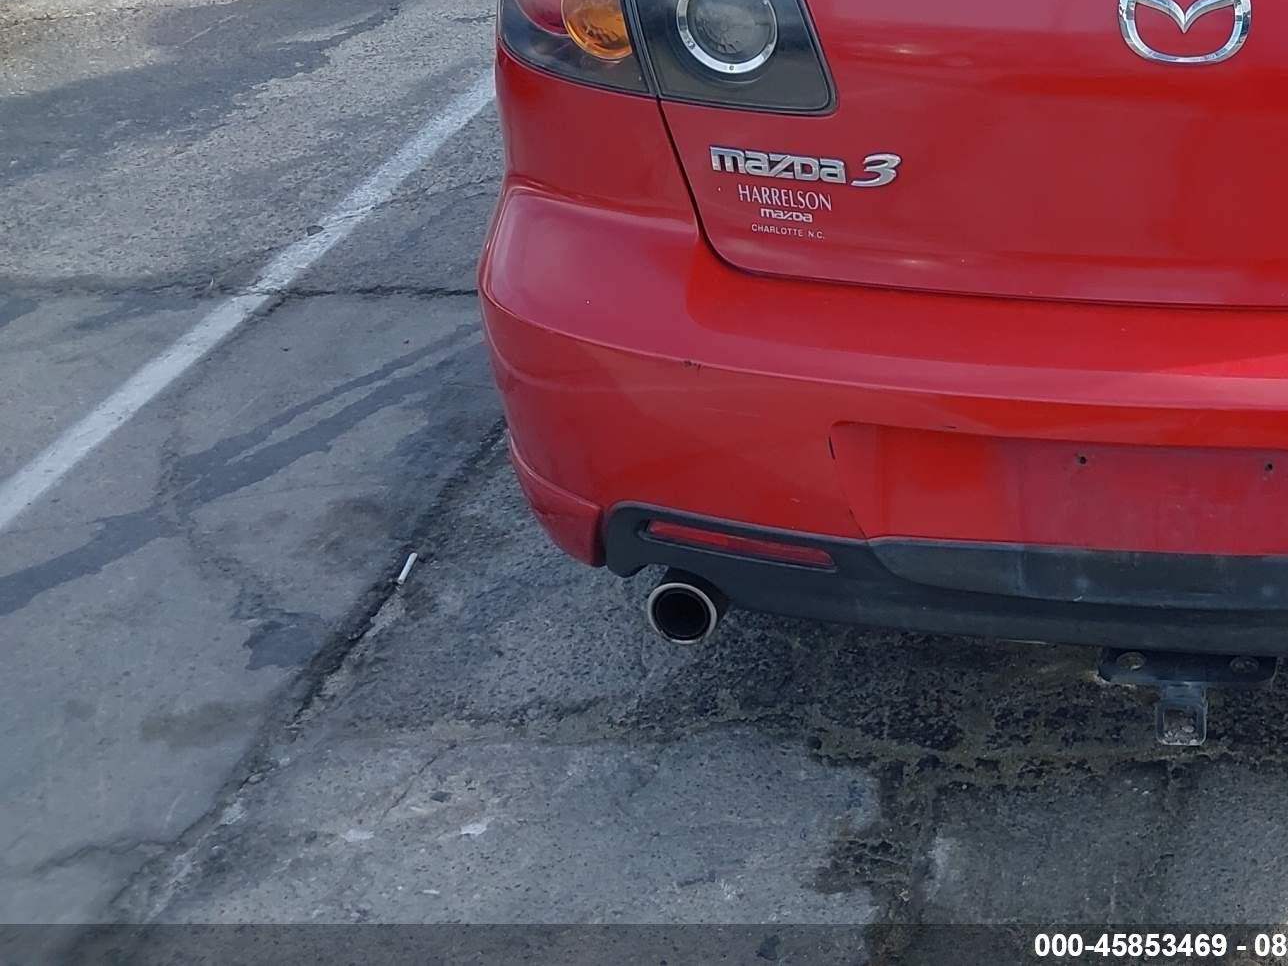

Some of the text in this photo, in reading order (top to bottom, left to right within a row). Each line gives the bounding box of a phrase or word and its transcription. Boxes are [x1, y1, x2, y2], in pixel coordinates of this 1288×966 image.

[851, 153, 902, 188] 3
[738, 184, 832, 211] HARRELSON
[751, 223, 803, 238] CHARLOTTE
